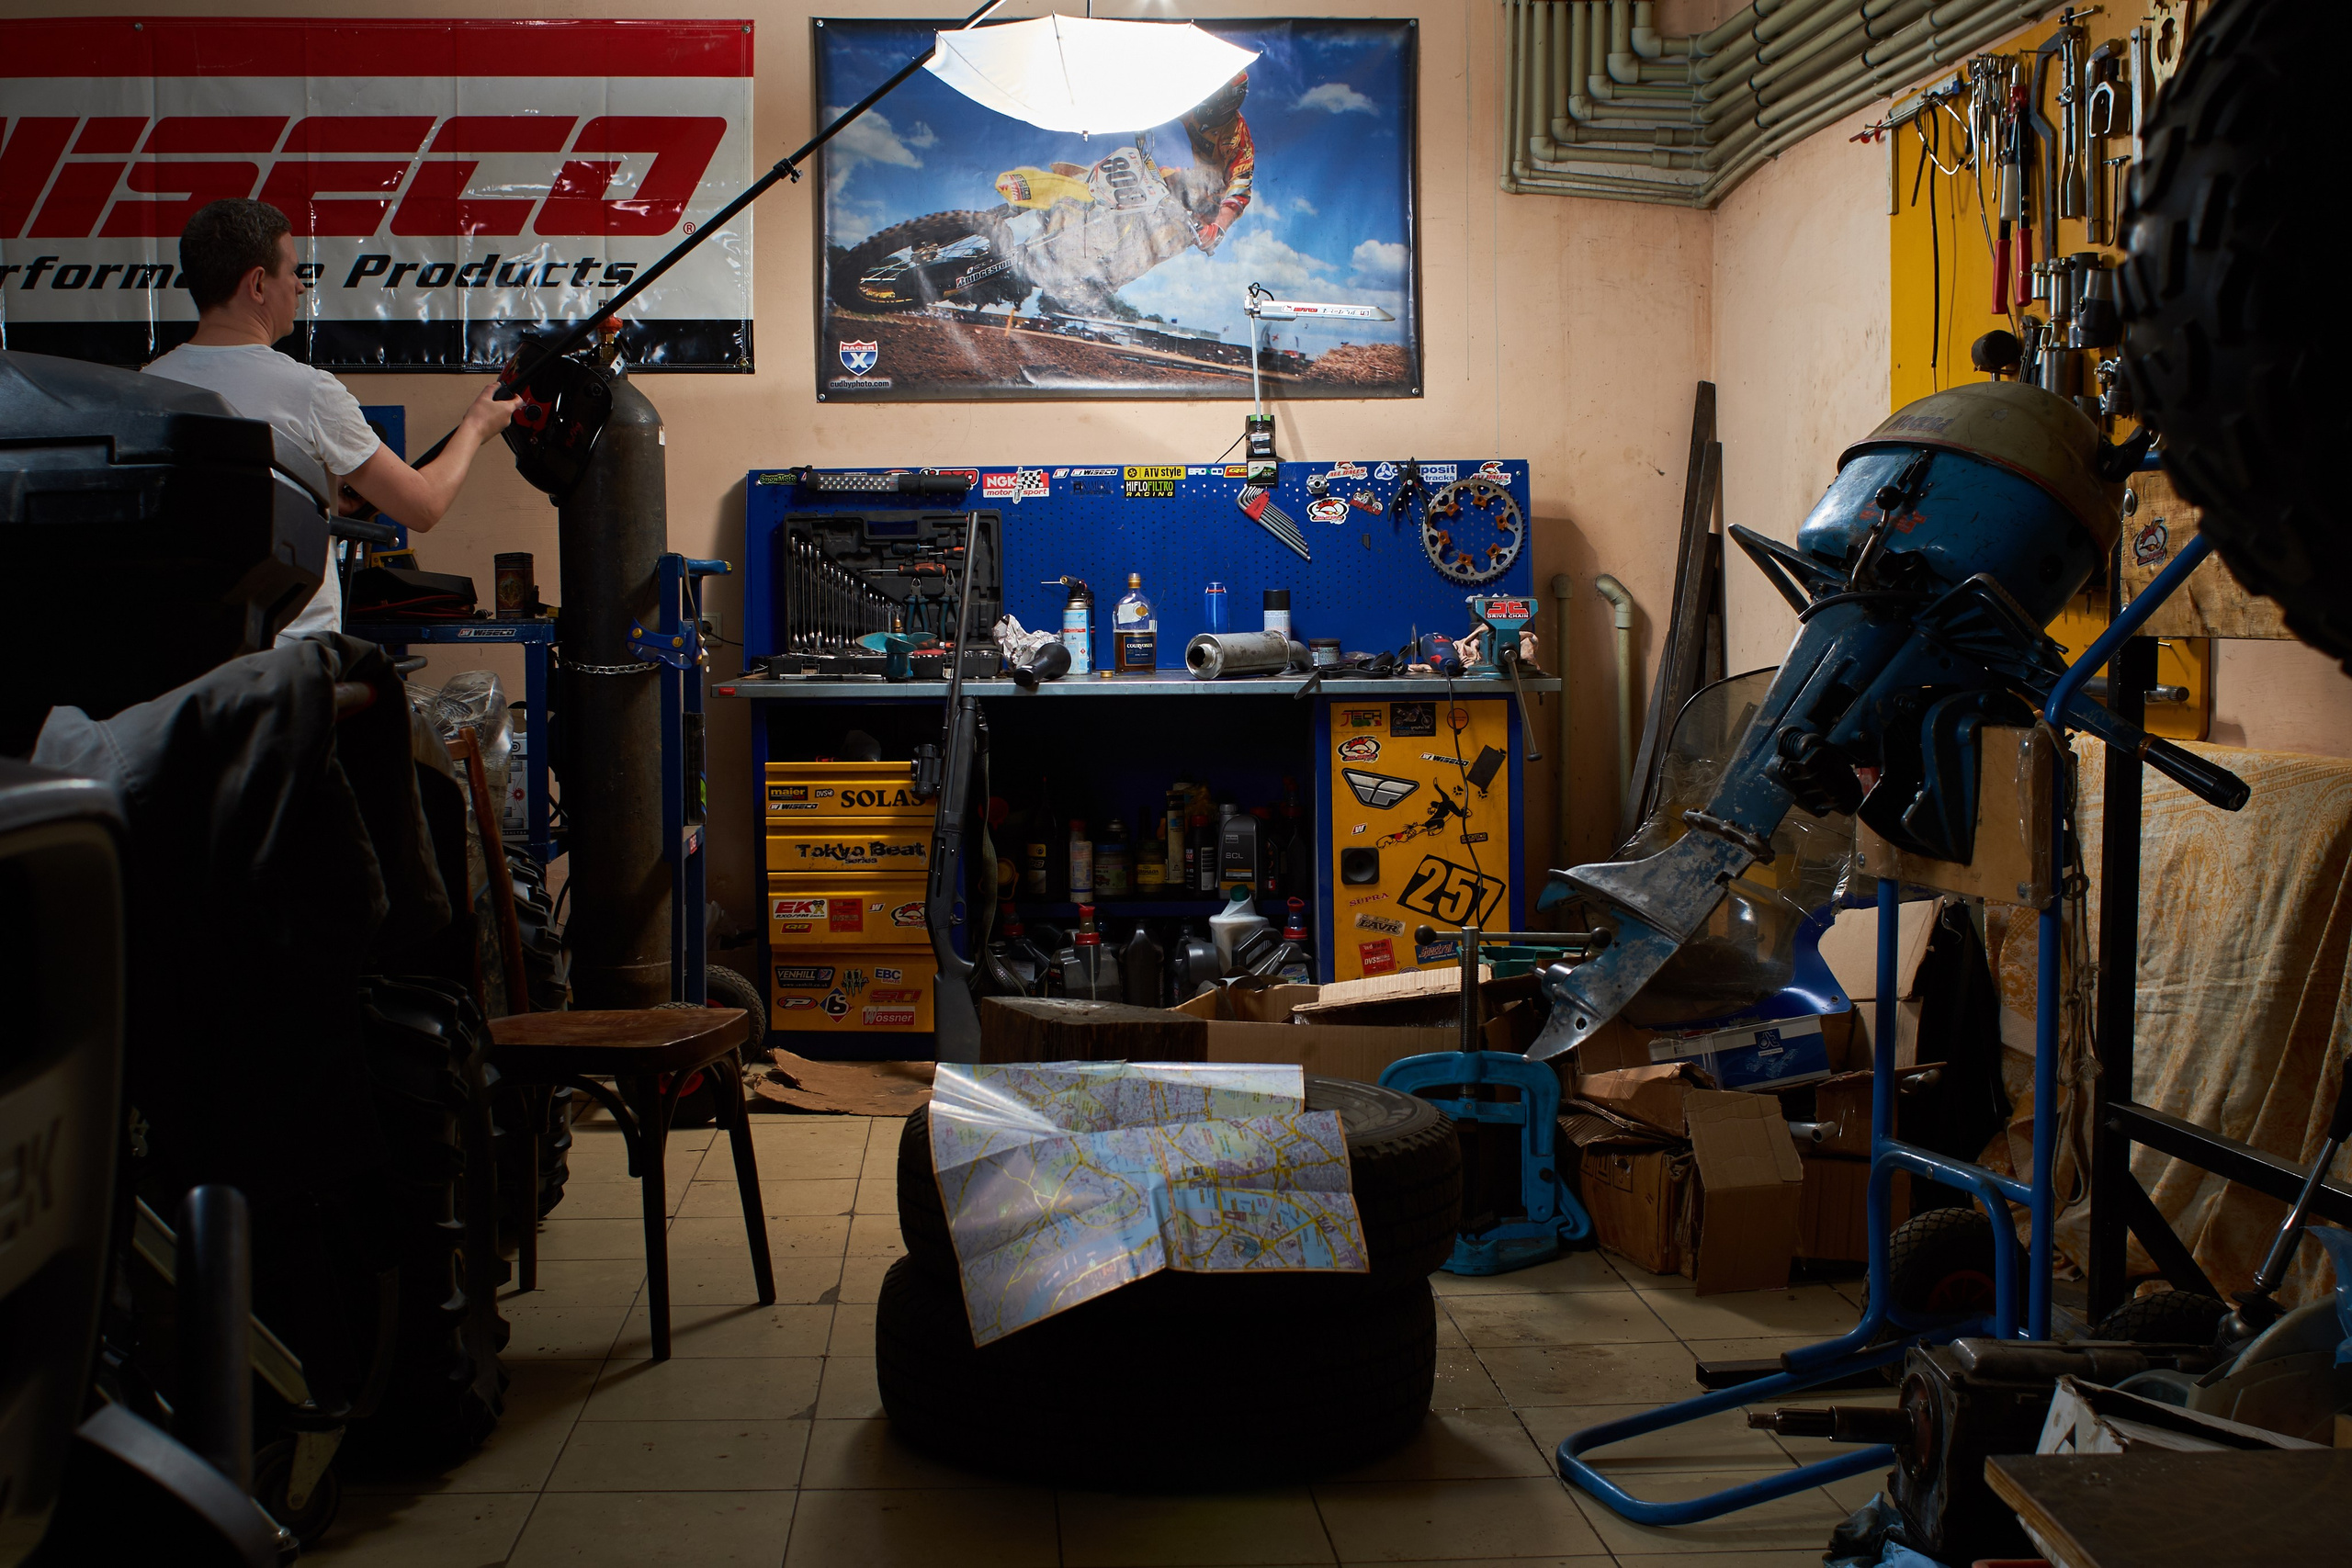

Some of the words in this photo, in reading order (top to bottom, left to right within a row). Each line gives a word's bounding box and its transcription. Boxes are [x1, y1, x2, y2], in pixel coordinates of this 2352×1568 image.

[344, 254, 638, 288] Products
[850, 353, 868, 368] X
[831, 380, 888, 389] cudbyphoto.com
[1145, 468, 1159, 477] ATV
[1160, 467, 1182, 478] style
[987, 476, 1017, 487] NGK
[1023, 489, 1046, 497] sport
[772, 787, 805, 795] maier
[796, 842, 865, 860] Tokyo
[867, 841, 927, 858] Beat
[1405, 859, 1502, 927] 257
[1349, 893, 1389, 907] SUPRA
[1359, 919, 1400, 934] LAVR
[778, 971, 816, 979] VENHILL
[876, 968, 900, 979] EBC
[865, 1007, 913, 1024] Wössner
